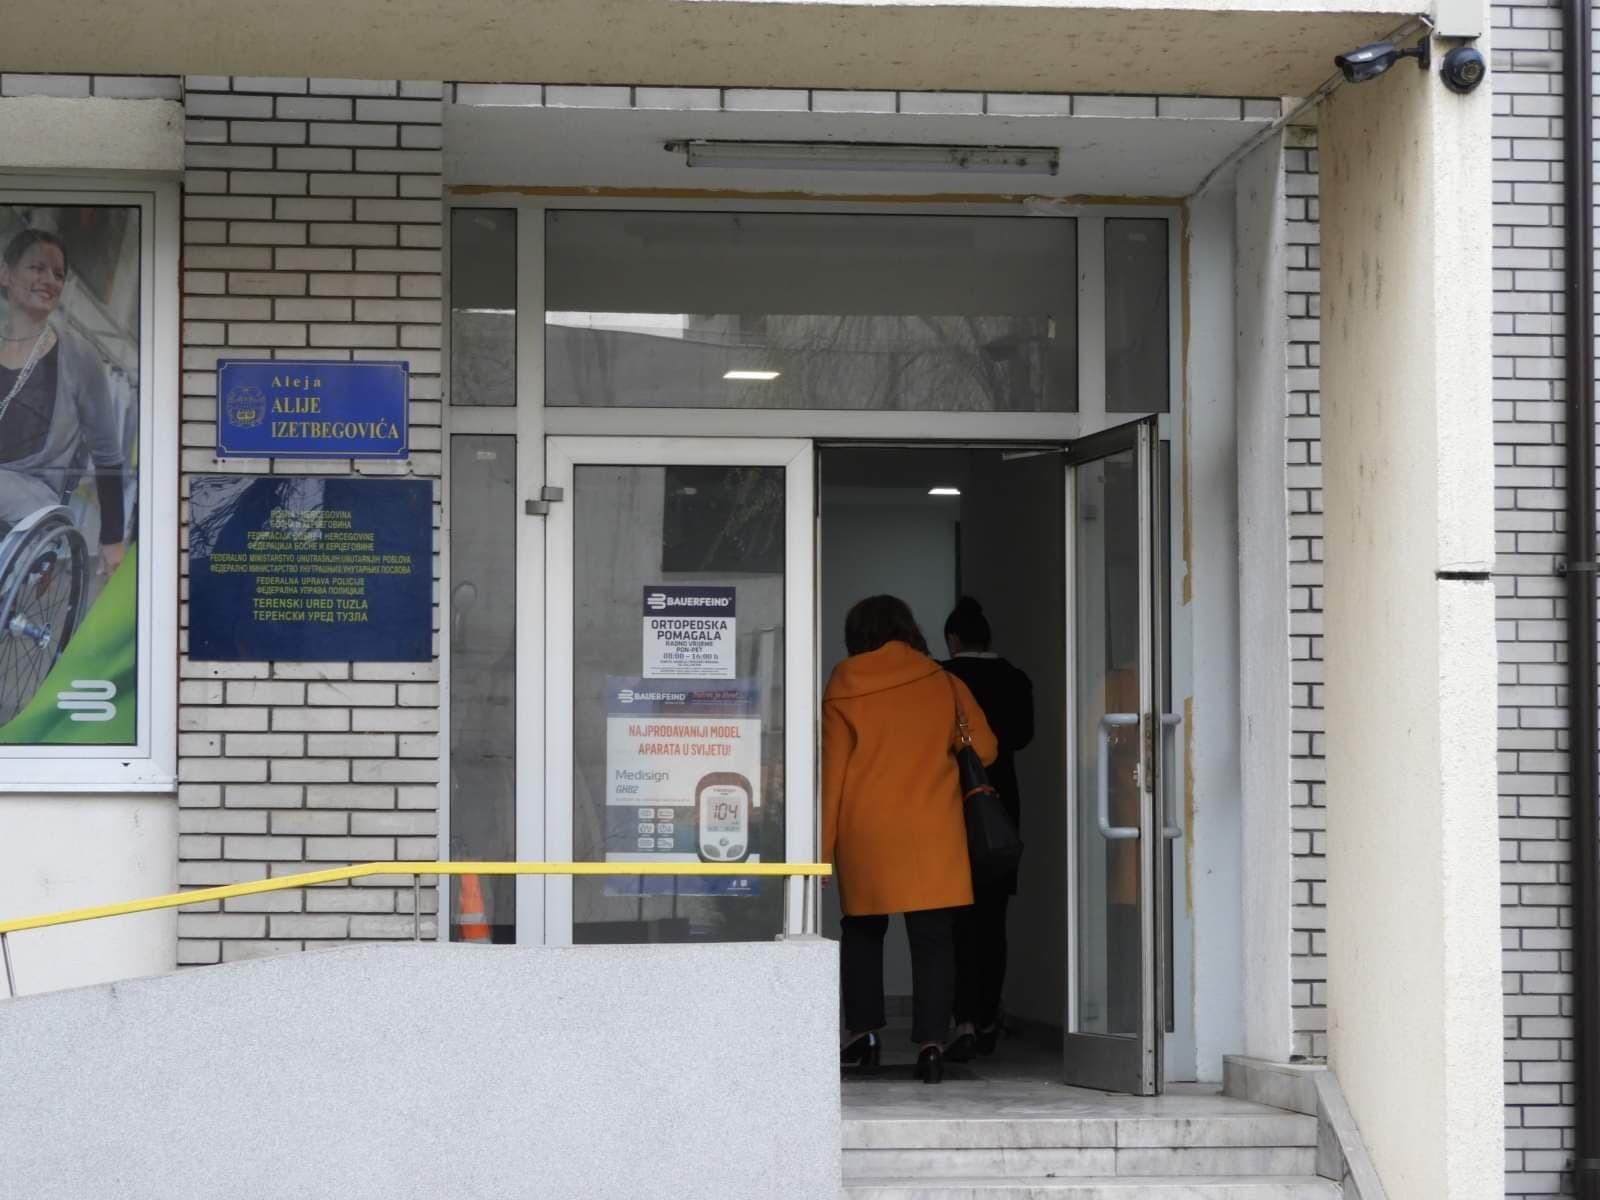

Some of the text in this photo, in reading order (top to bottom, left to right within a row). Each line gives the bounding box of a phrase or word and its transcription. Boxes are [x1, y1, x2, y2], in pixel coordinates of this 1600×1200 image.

[272, 375, 321, 390] Aleja
[272, 397, 321, 413] ALIJE
[272, 418, 399, 439] IZETBEGOVIĆA
[325, 533, 374, 541] HERCEGOVINE
[256, 576, 365, 586] FEDERALNA UPRAVA POLICIJE
[253, 598, 369, 609] TERENSKI URED TUZLA
[666, 596, 729, 607] BAUERFEIND
[253, 610, 369, 623] ТЕРЕНСКИ УРЕД ТУЗЛА
[651, 619, 728, 631] ORTOPEDSKA
[657, 630, 722, 641] POMAGALA
[633, 691, 687, 701] BAUERFEIND
[628, 724, 742, 738] NAJPRODAVANIJI MODEL
[638, 743, 732, 757] APARATA U SVIJETU!
[615, 769, 670, 783] Medisign
[713, 803, 739, 821] 104
